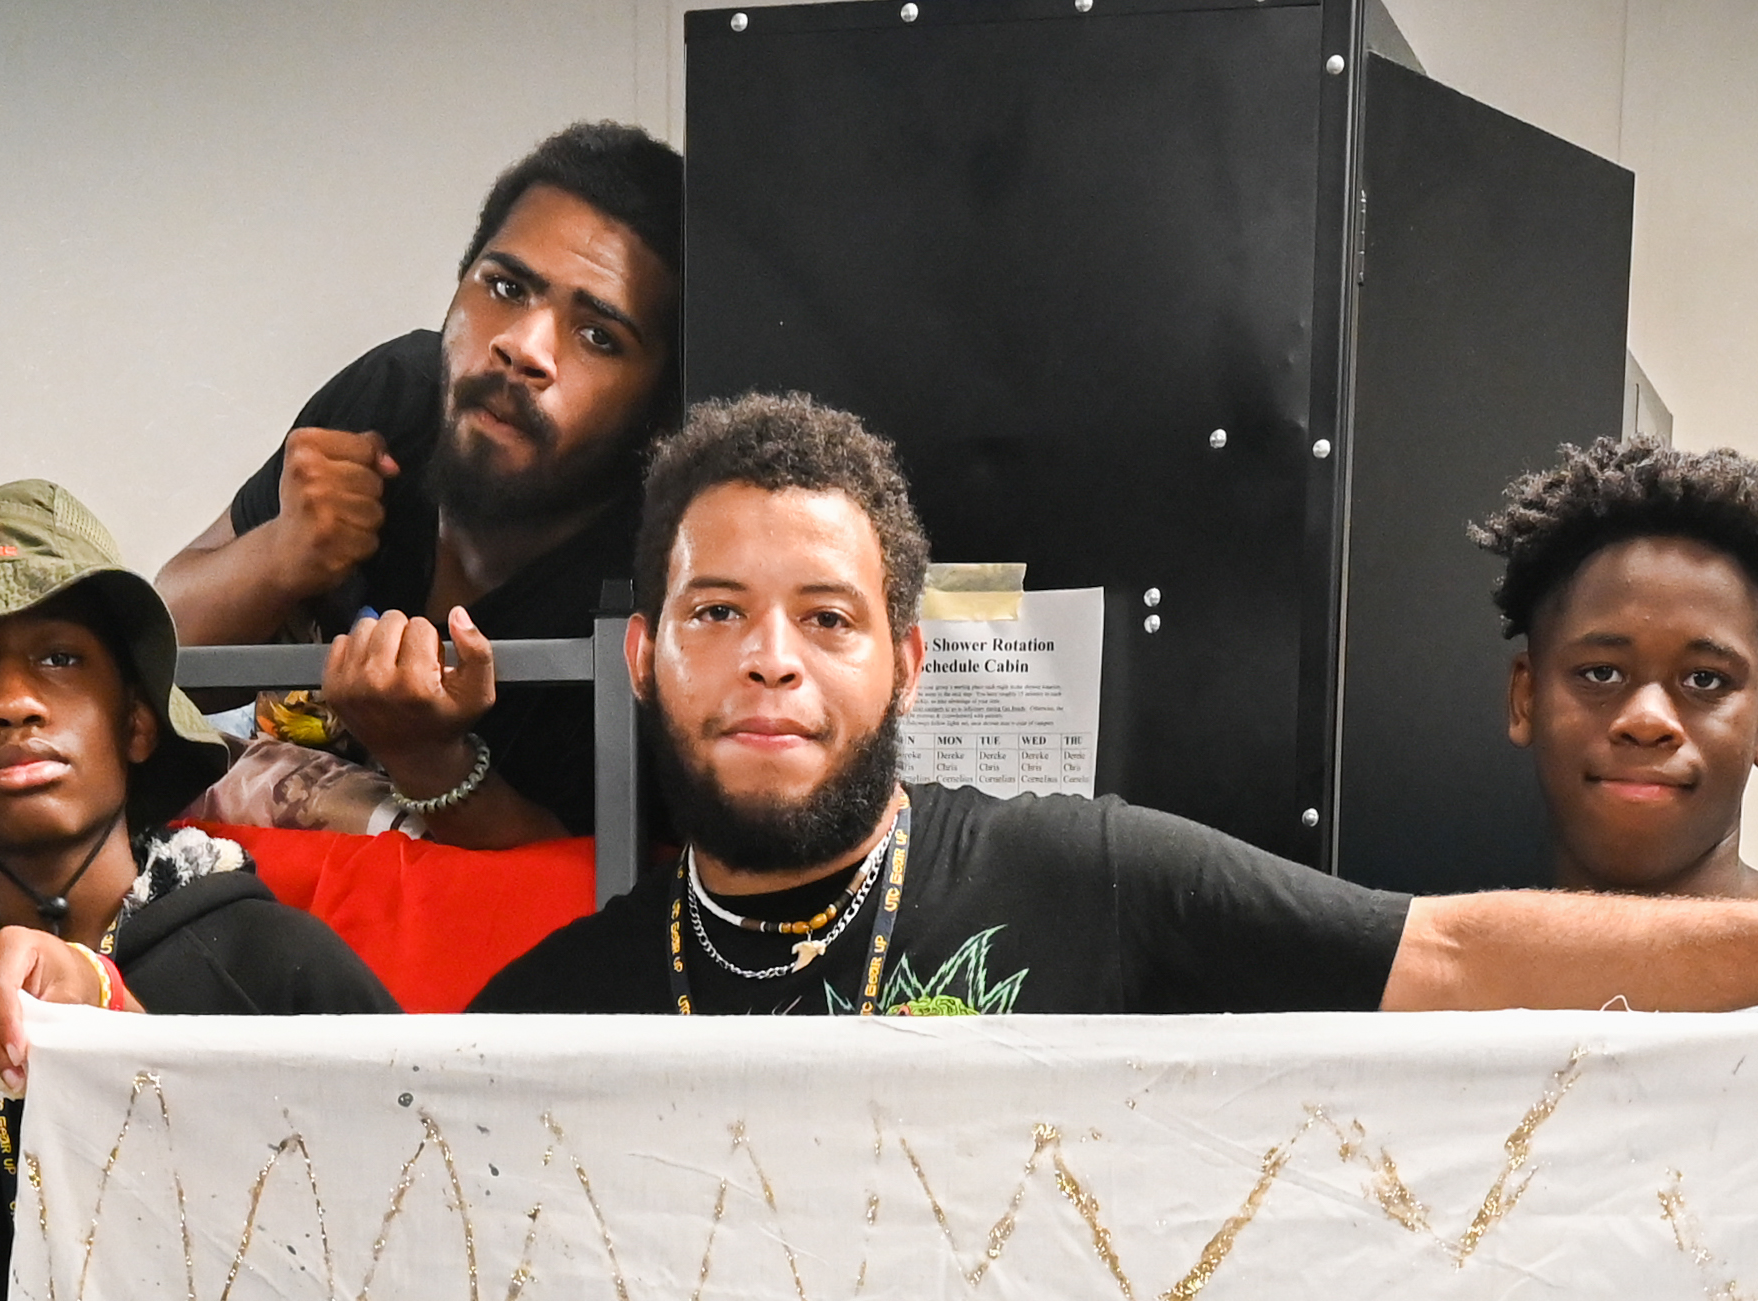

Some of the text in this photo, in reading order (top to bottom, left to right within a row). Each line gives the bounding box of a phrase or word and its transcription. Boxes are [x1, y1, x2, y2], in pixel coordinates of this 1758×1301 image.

[932, 638, 987, 652] Shower
[992, 638, 1055, 652] Rotation
[921, 659, 1029, 674] chedule Cabin
[937, 736, 963, 745] MON
[979, 736, 1001, 745] TUE
[1021, 736, 1047, 745] WED
